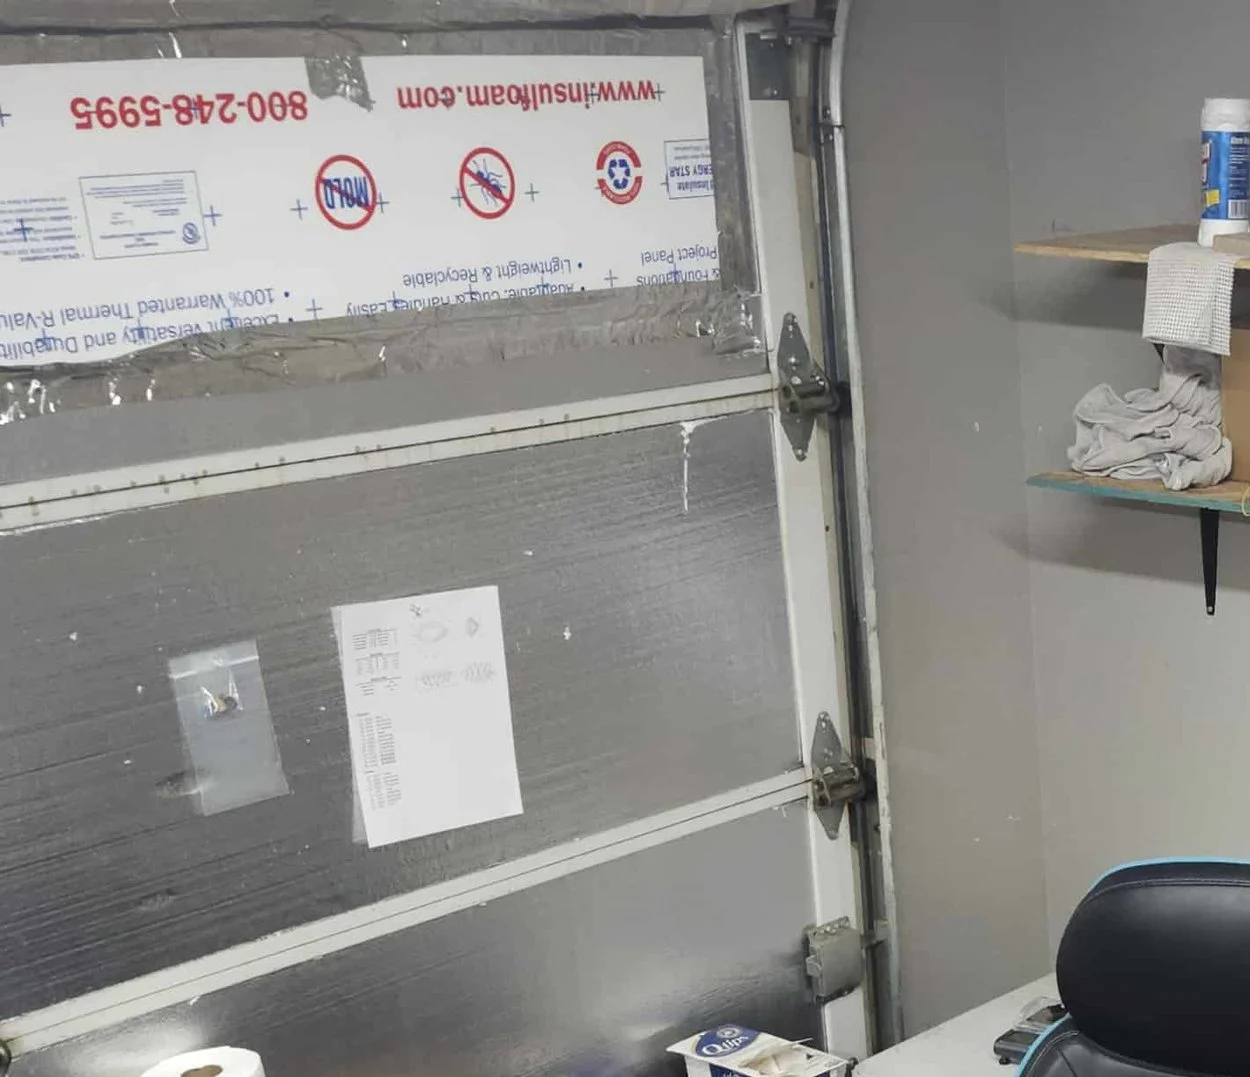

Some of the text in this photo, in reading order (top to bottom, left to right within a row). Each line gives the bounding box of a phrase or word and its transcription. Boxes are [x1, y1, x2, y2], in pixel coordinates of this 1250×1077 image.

[397, 79, 657, 113] www.insulfoam.com
[69, 90, 309, 131] 800-248-5995
[323, 176, 369, 211] MOLD
[641, 243, 717, 266] Project Panel
[402, 256, 572, 288] Lightweight & Recyclable
[137, 292, 225, 317] Warranted
[227, 287, 275, 310] 100%
[60, 301, 134, 327] Thermal
[83, 333, 117, 352] and
